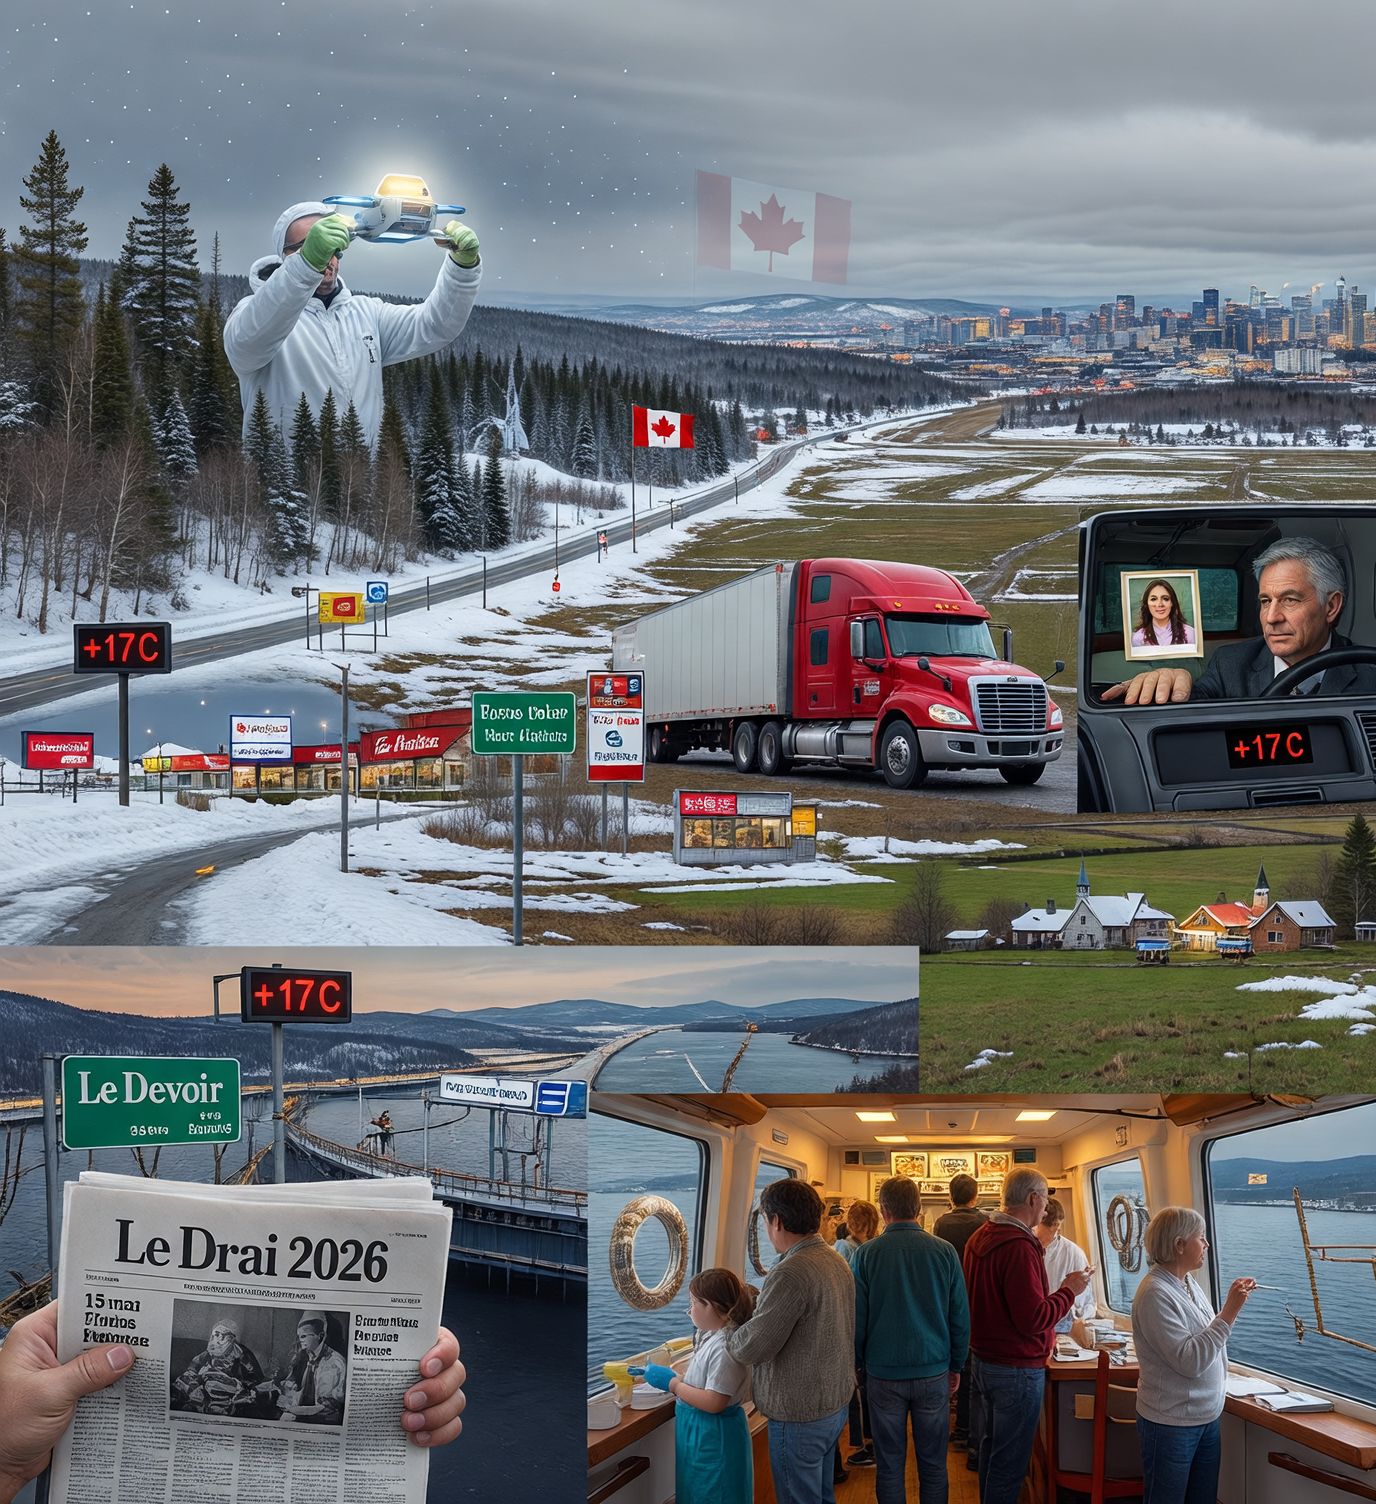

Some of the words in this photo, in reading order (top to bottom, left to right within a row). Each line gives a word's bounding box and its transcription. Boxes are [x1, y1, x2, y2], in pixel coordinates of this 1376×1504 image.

[83, 632, 159, 662] +17C
[254, 979, 341, 1013] +17C
[77, 1071, 118, 1104] Le
[122, 1071, 224, 1104] Devoir
[114, 1218, 171, 1266] Le
[178, 1225, 278, 1277] Drai
[287, 1236, 389, 1283] 2026
[85, 1293, 106, 1309] 15
